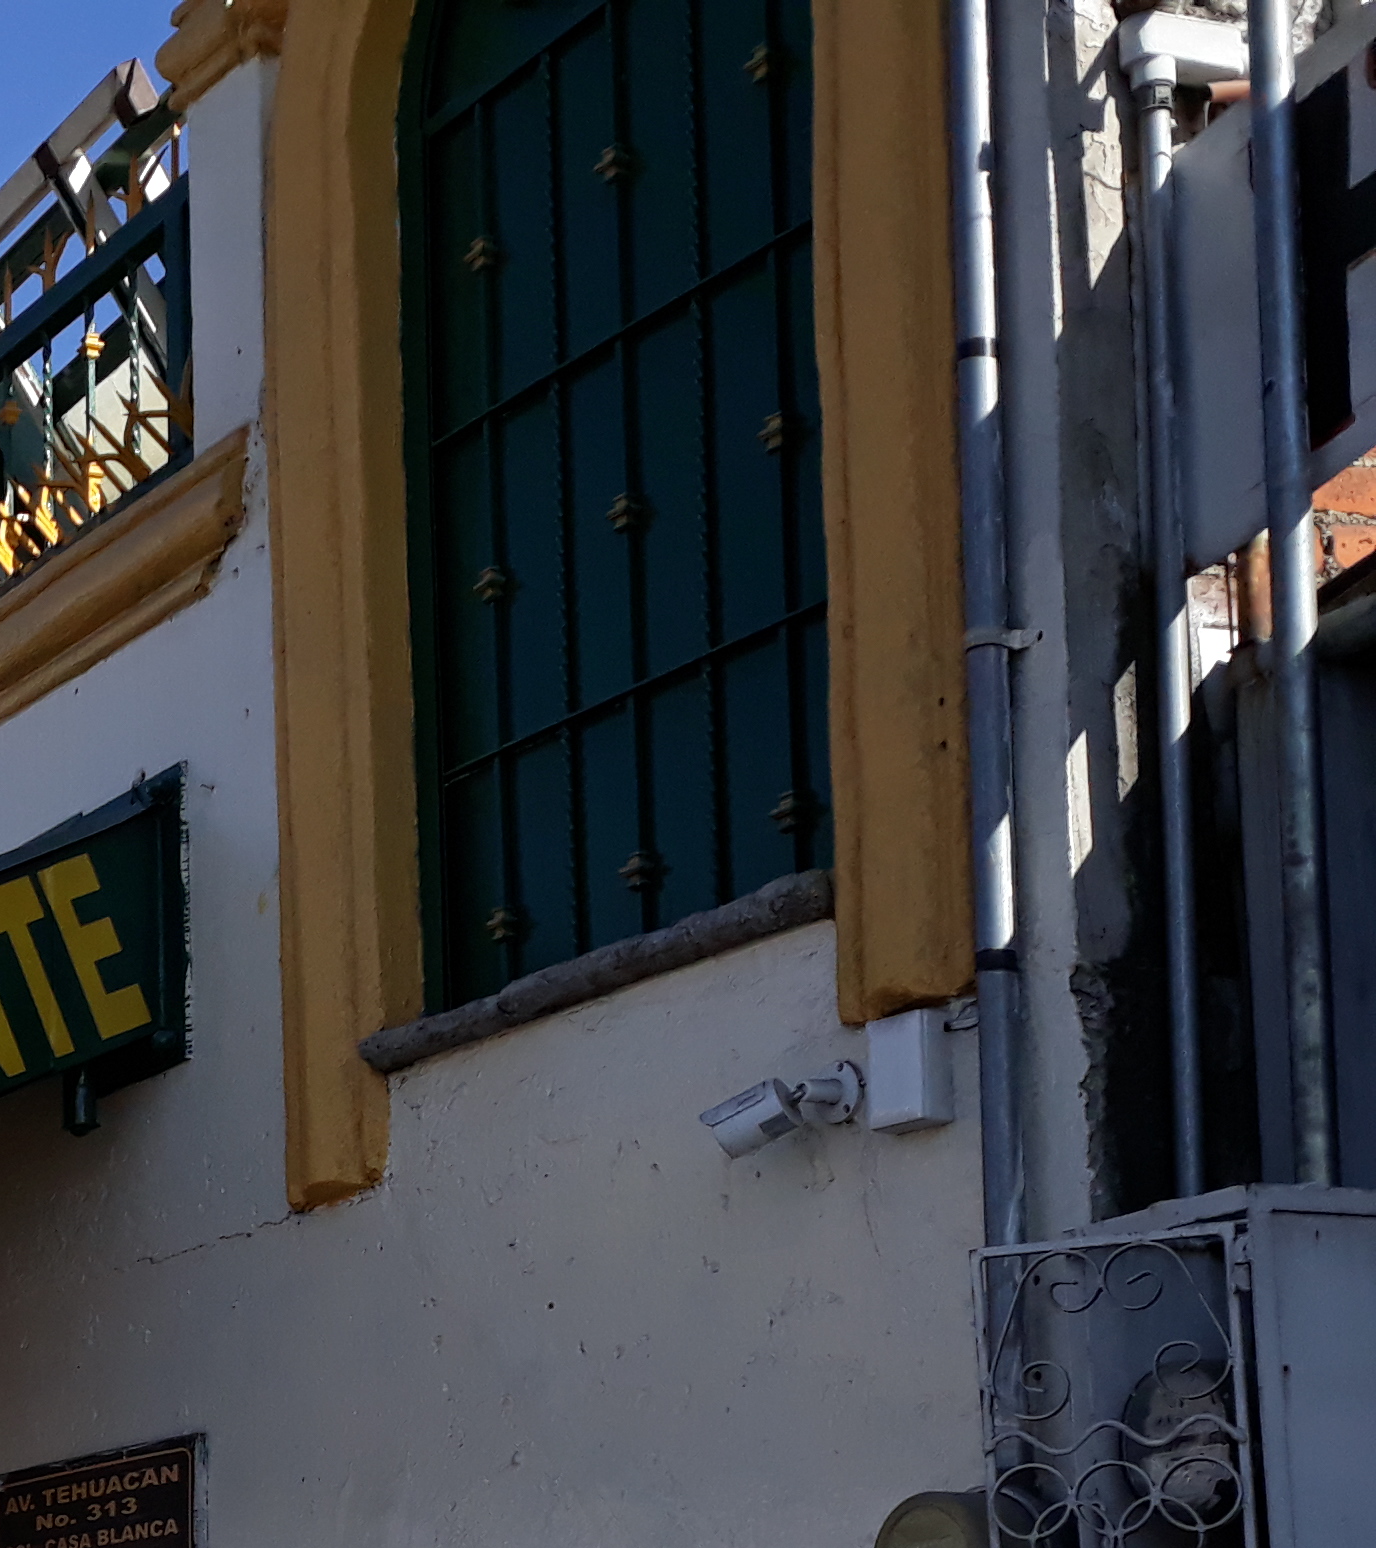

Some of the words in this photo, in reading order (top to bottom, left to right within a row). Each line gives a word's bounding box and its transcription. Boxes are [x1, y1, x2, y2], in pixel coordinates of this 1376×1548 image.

[5, 1493, 35, 1515] AV.
[41, 1463, 180, 1506] TEHUACAN
[35, 1512, 77, 1531] No.
[86, 1496, 138, 1521] 313
[97, 1518, 179, 1546] BLANCA
